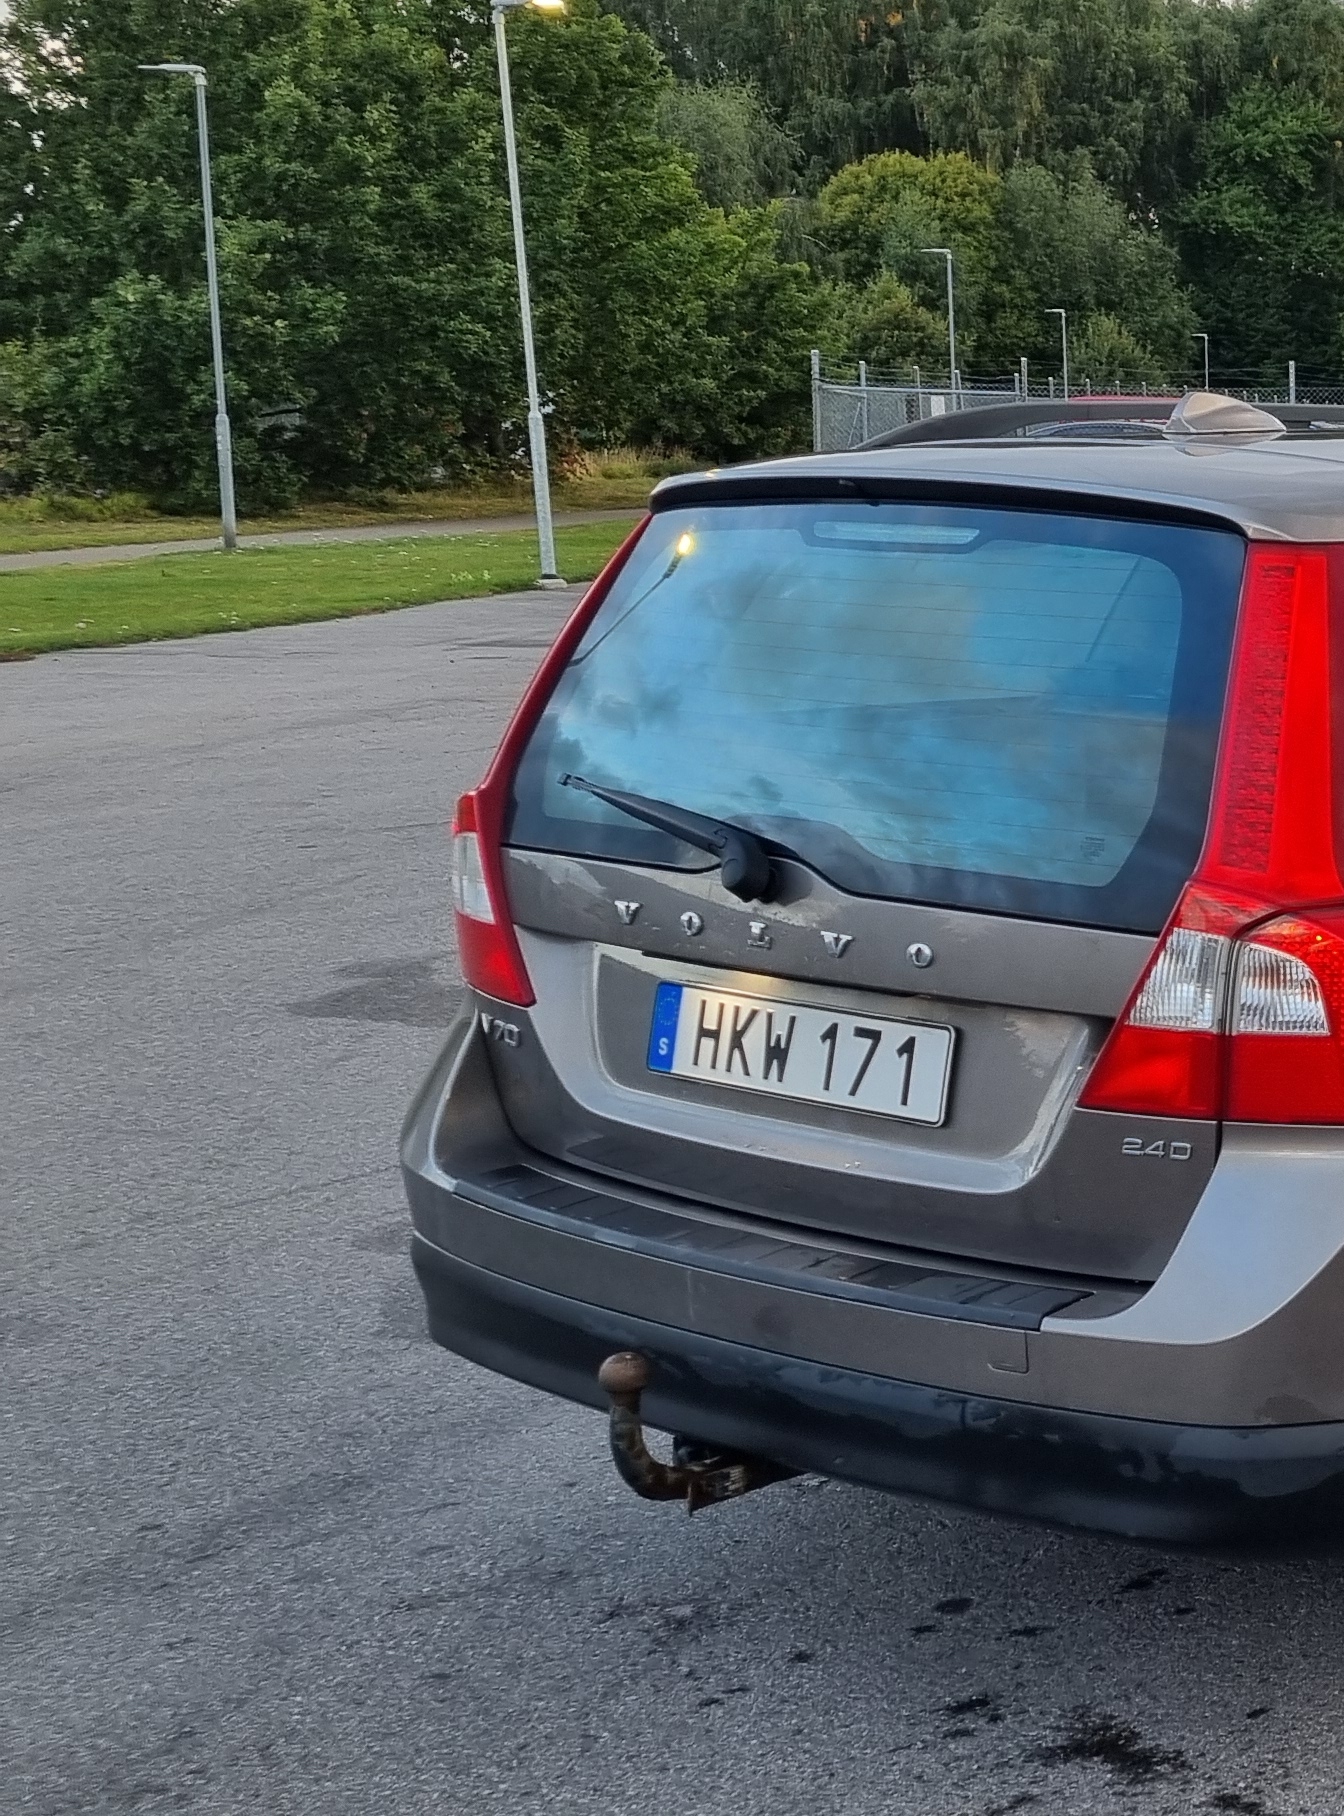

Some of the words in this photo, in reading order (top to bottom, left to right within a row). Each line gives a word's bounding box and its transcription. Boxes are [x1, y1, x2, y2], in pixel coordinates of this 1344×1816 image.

[614, 900, 934, 968] VOLVO
[481, 1012, 520, 1047] V70
[658, 1037, 669, 1056] S
[691, 999, 797, 1083] HKW
[819, 1021, 917, 1107] 171
